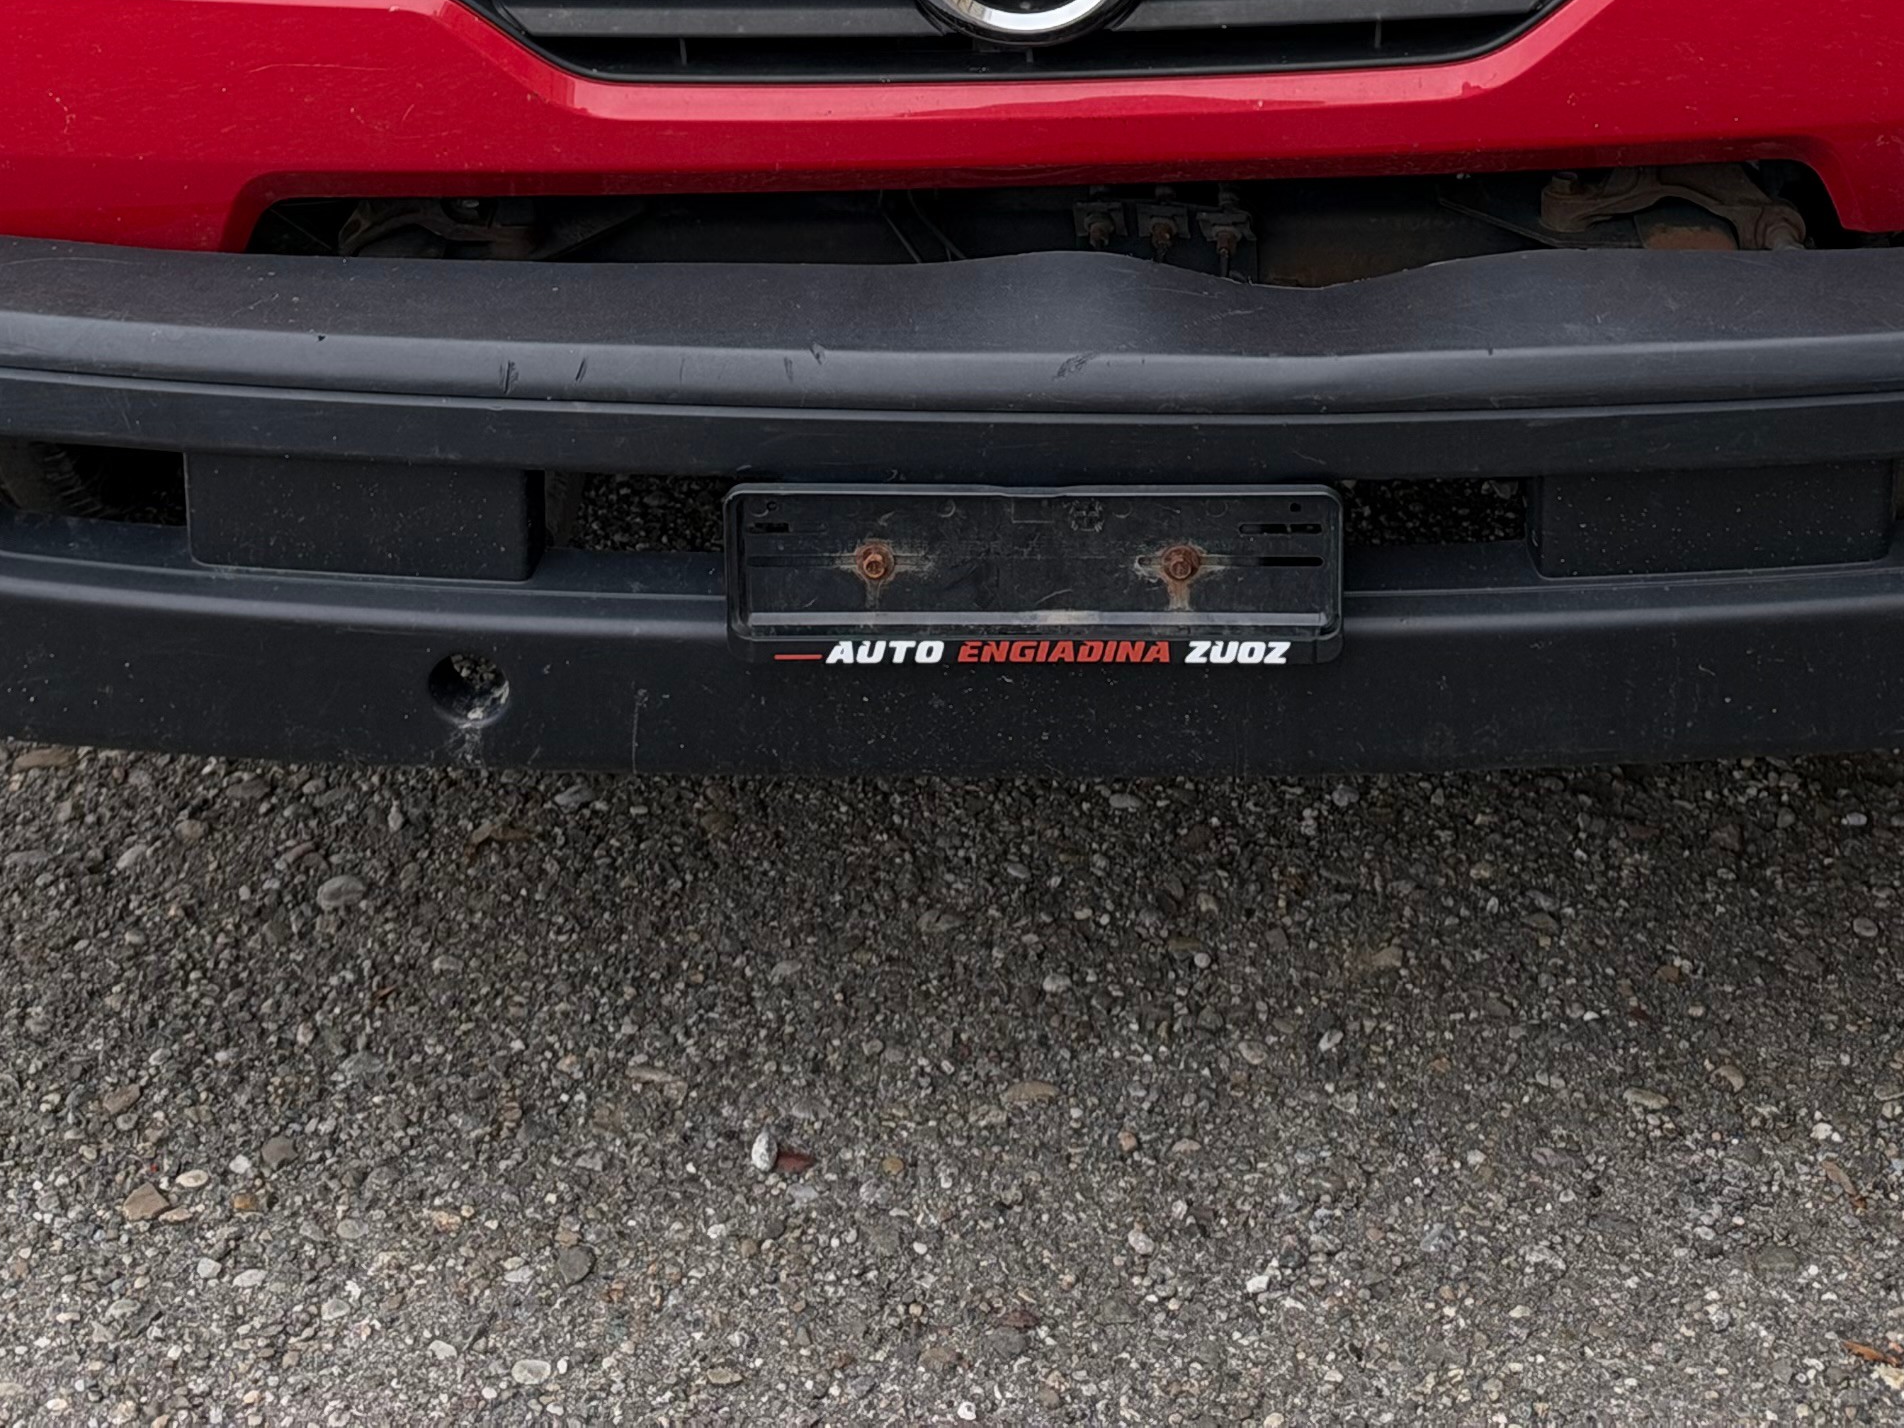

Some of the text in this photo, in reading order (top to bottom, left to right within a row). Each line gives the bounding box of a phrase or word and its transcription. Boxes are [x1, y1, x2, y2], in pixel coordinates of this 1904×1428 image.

[825, 639, 1293, 664] AUTO ENGIADINA ZUOZ
